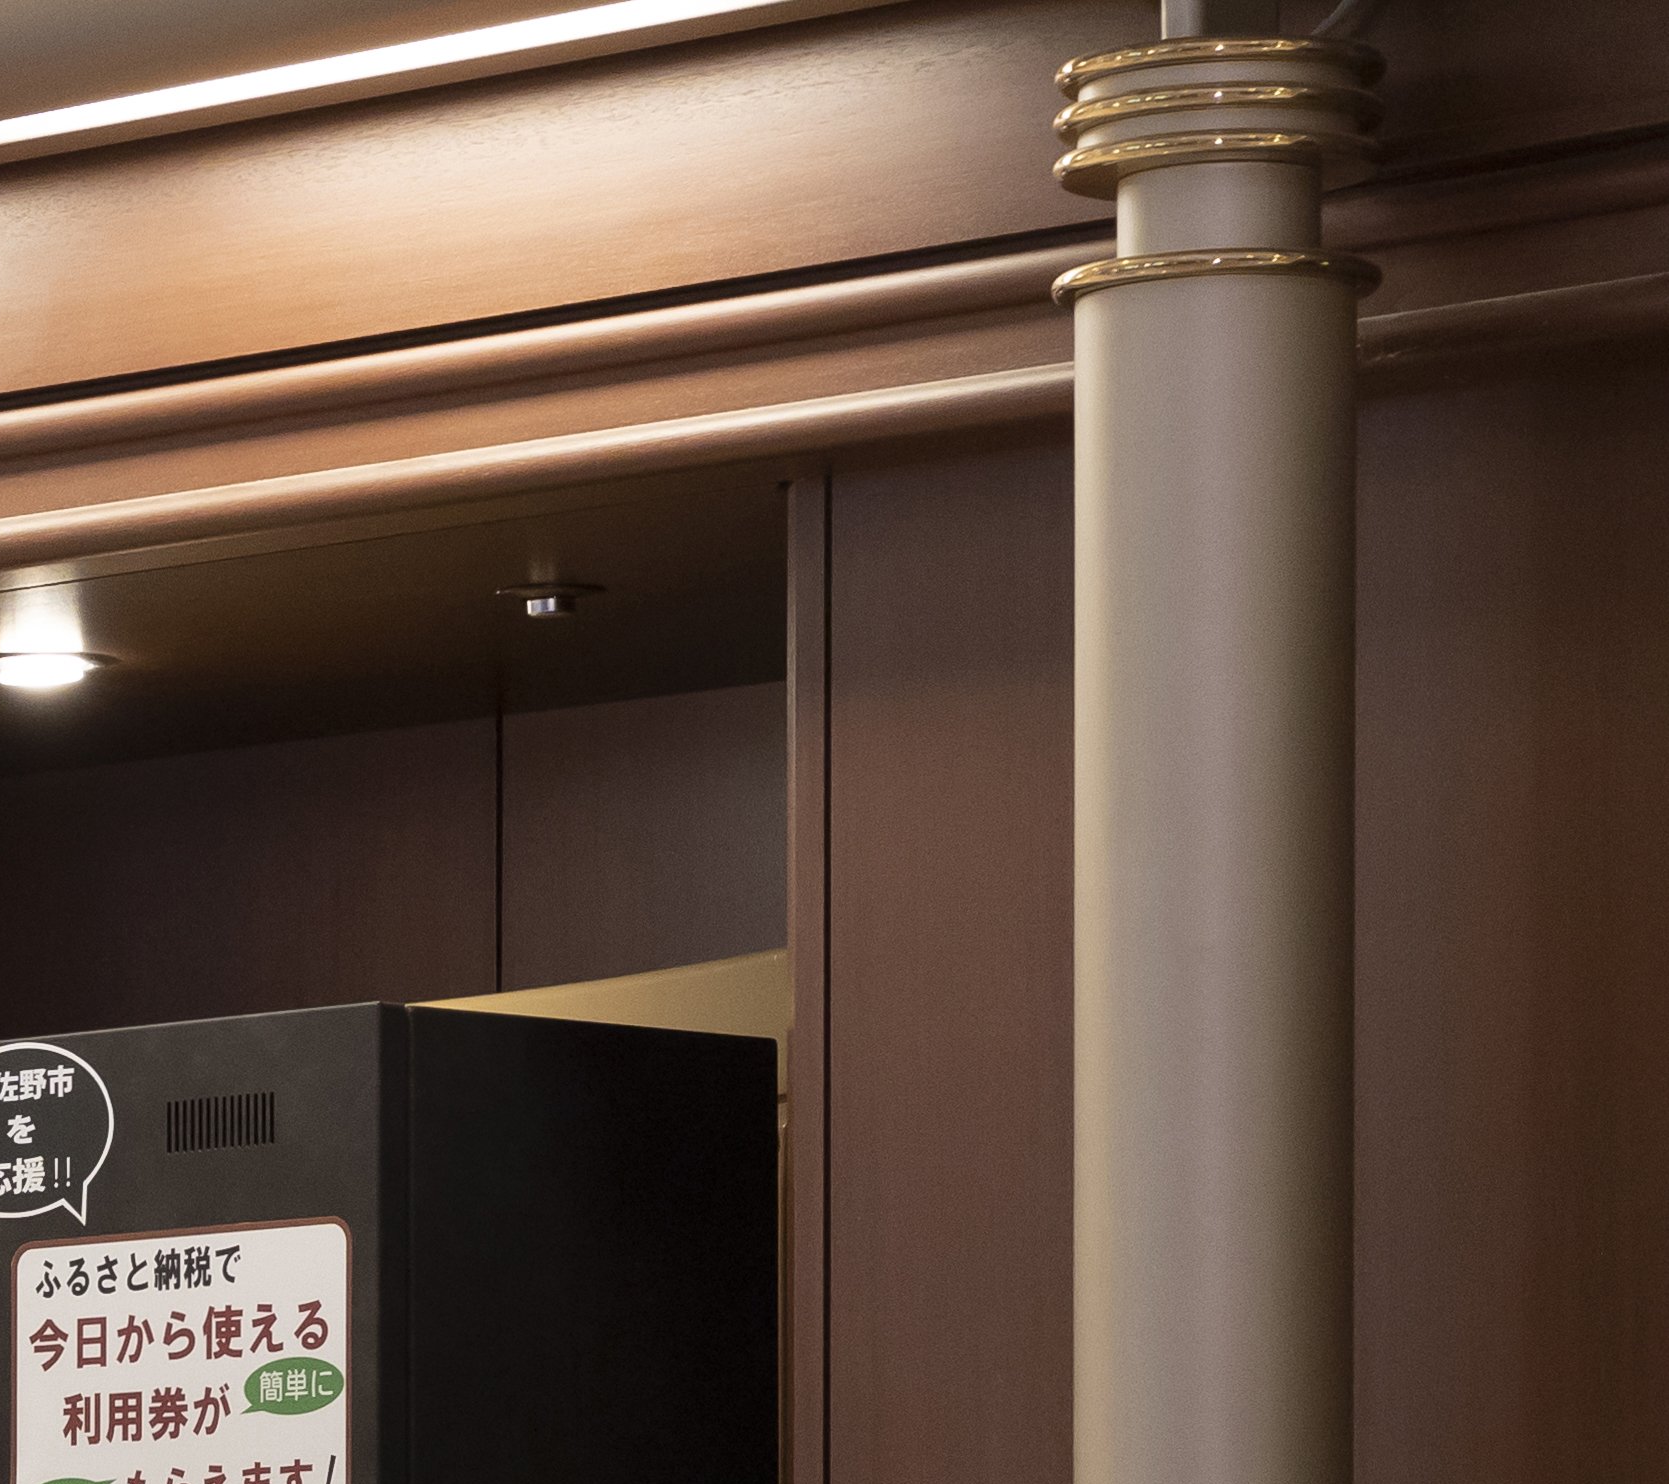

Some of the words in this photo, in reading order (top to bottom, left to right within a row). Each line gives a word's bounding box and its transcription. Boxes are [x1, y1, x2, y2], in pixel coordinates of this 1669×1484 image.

[7, 1114, 35, 1145] を
[35, 1244, 241, 1299] ふるさと納税で
[29, 1300, 330, 1371] 今日から使える
[259, 1369, 334, 1404] 簡単に
[63, 1383, 232, 1446] 利用券が
